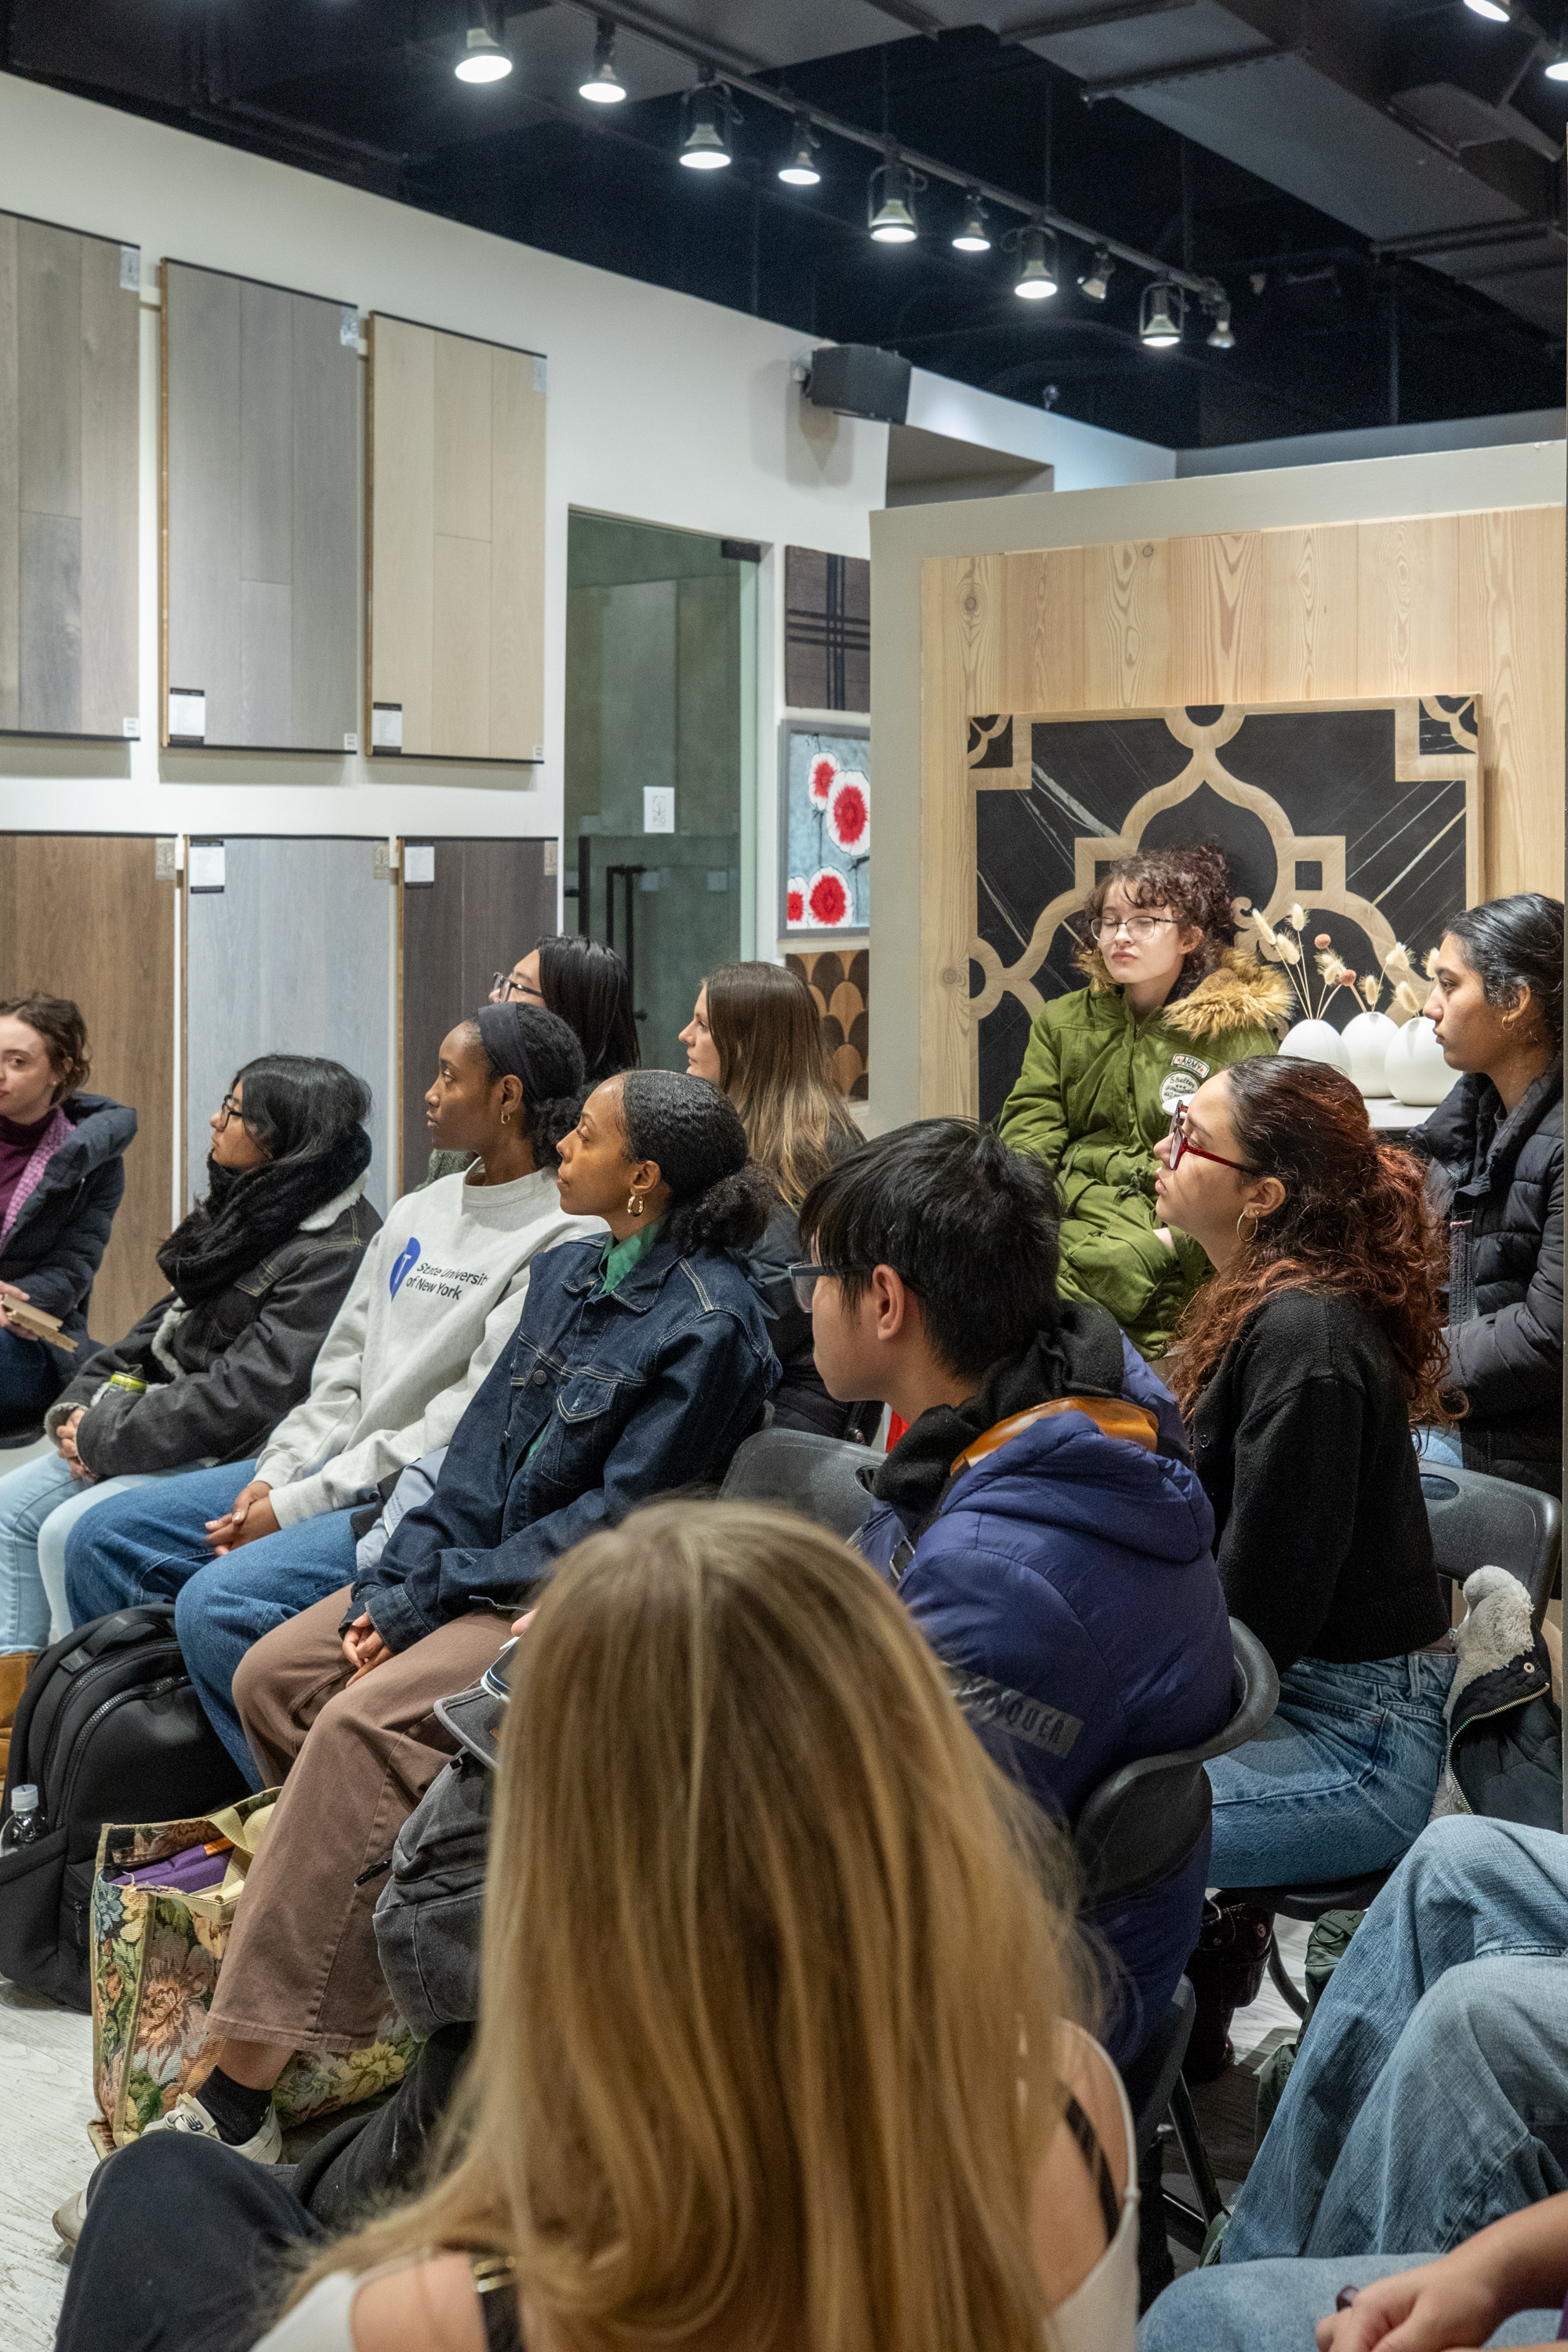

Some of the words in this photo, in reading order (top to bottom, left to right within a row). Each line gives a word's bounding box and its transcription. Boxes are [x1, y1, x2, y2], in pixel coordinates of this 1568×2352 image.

[1181, 1056, 1201, 1071] ARMY
[1170, 1076, 1196, 1089] Shelter
[417, 1262, 442, 1276] State
[406, 1276, 420, 1287] of
[416, 1278, 437, 1293] New
[436, 1283, 462, 1300] York
